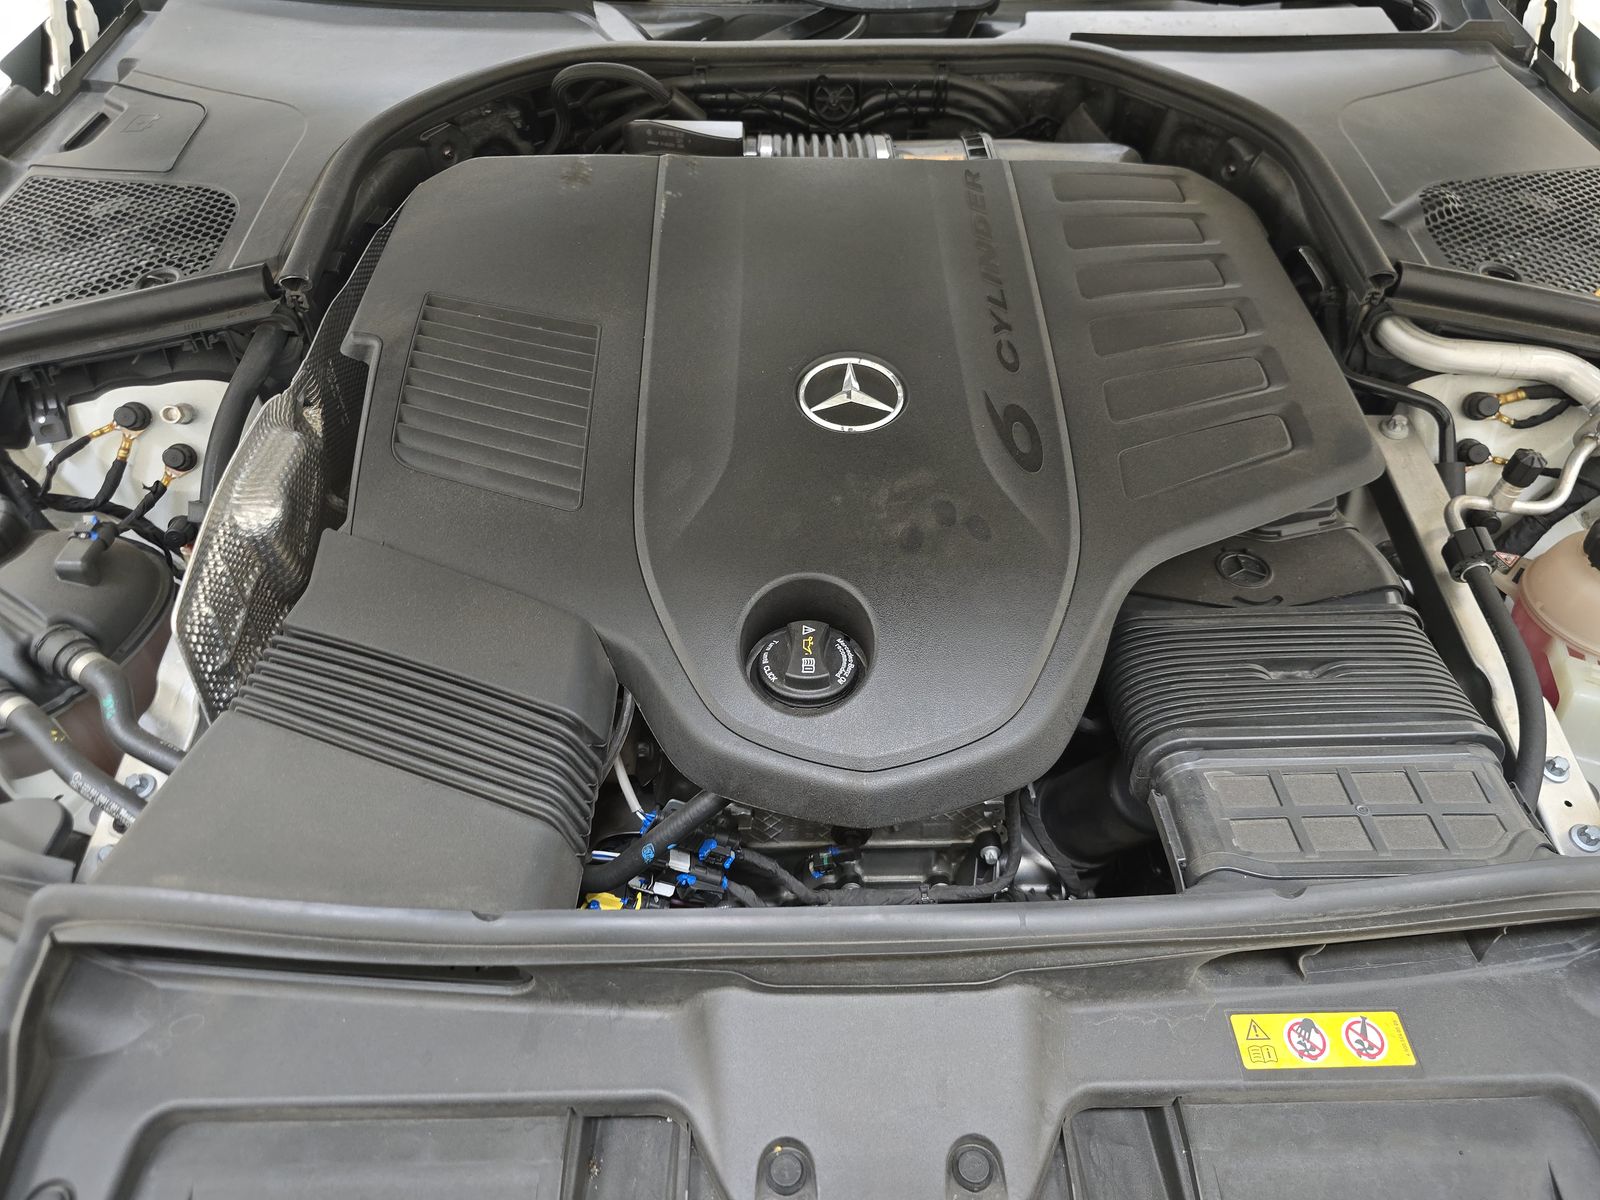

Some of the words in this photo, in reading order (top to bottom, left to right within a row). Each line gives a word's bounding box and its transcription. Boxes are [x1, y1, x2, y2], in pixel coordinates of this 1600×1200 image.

[964, 168, 1020, 373] CYLINDER
[983, 389, 1044, 474] 6
[765, 640, 779, 651] Turn
[836, 638, 855, 677] Mercedes-Benz
[763, 665, 778, 682] CLICK
